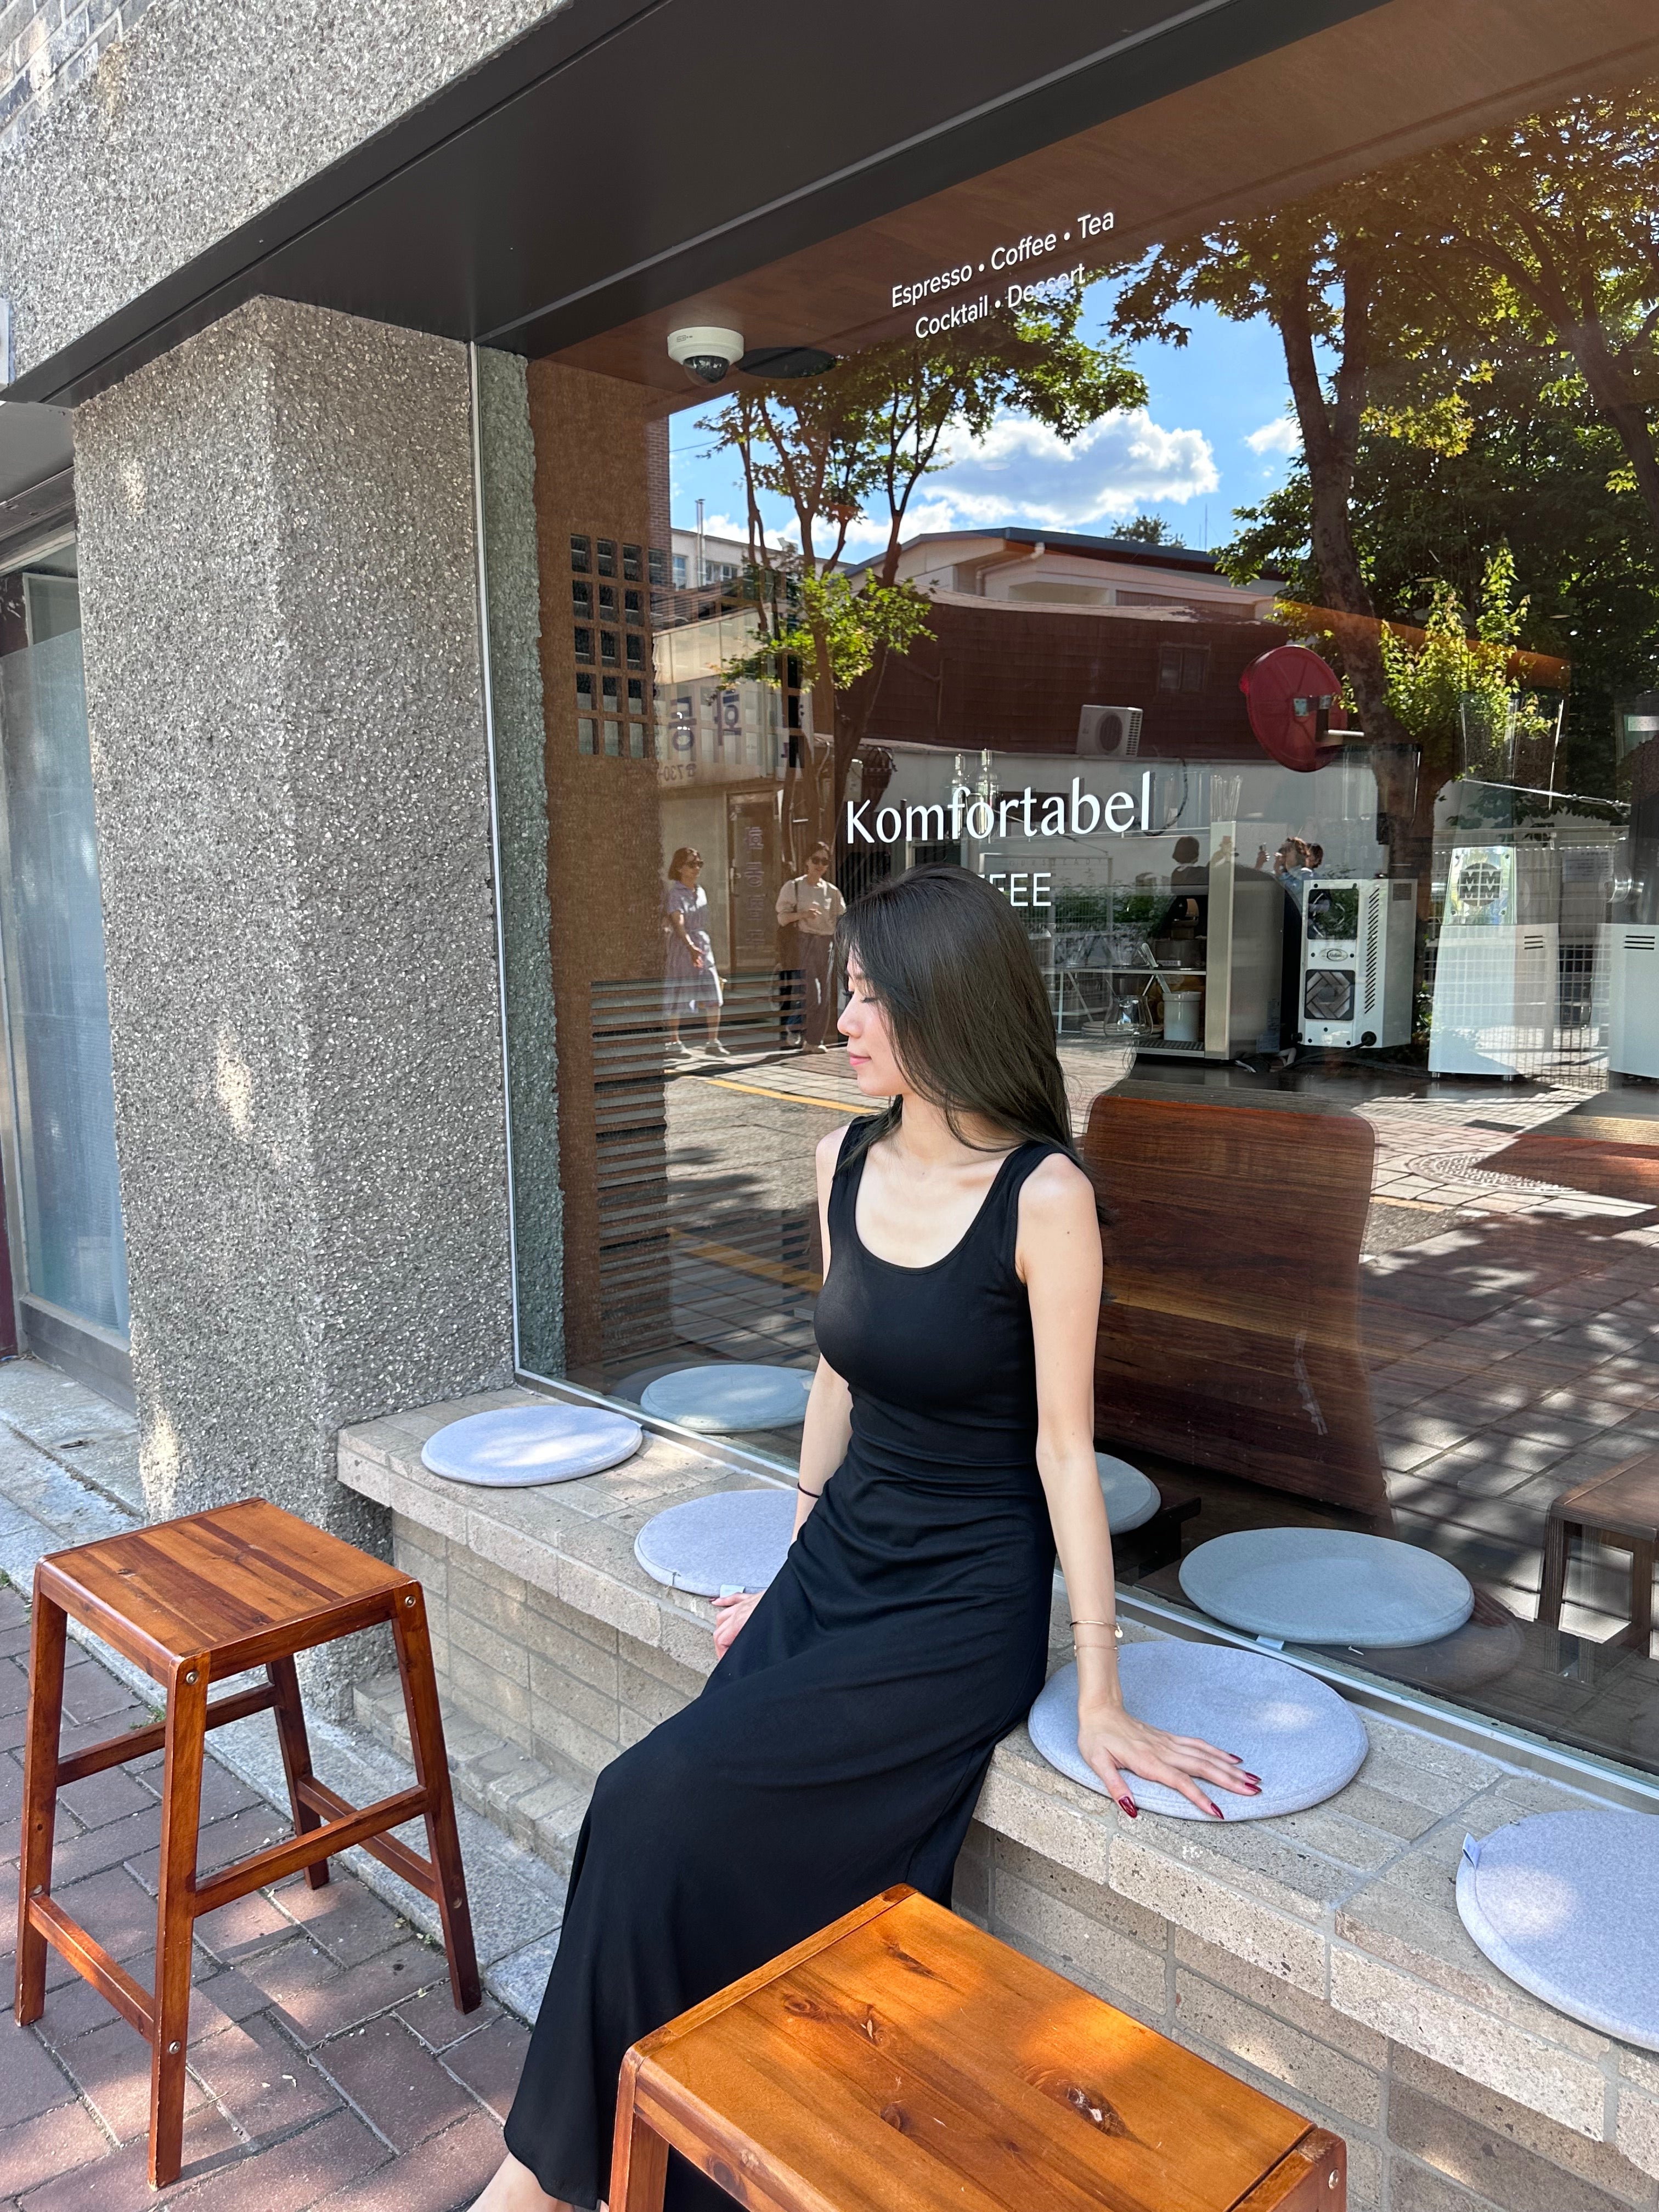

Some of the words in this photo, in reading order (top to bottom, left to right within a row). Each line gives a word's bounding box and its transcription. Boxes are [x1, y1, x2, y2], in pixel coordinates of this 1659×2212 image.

[892, 265, 972, 308] Espresso
[991, 233, 1057, 270] Coffee
[1077, 212, 1114, 239] Tea
[916, 295, 988, 338] Cocktail
[1008, 263, 1085, 308] Dessert
[847, 771, 1150, 844] Komfortabel
[978, 872, 1052, 906] FEE
